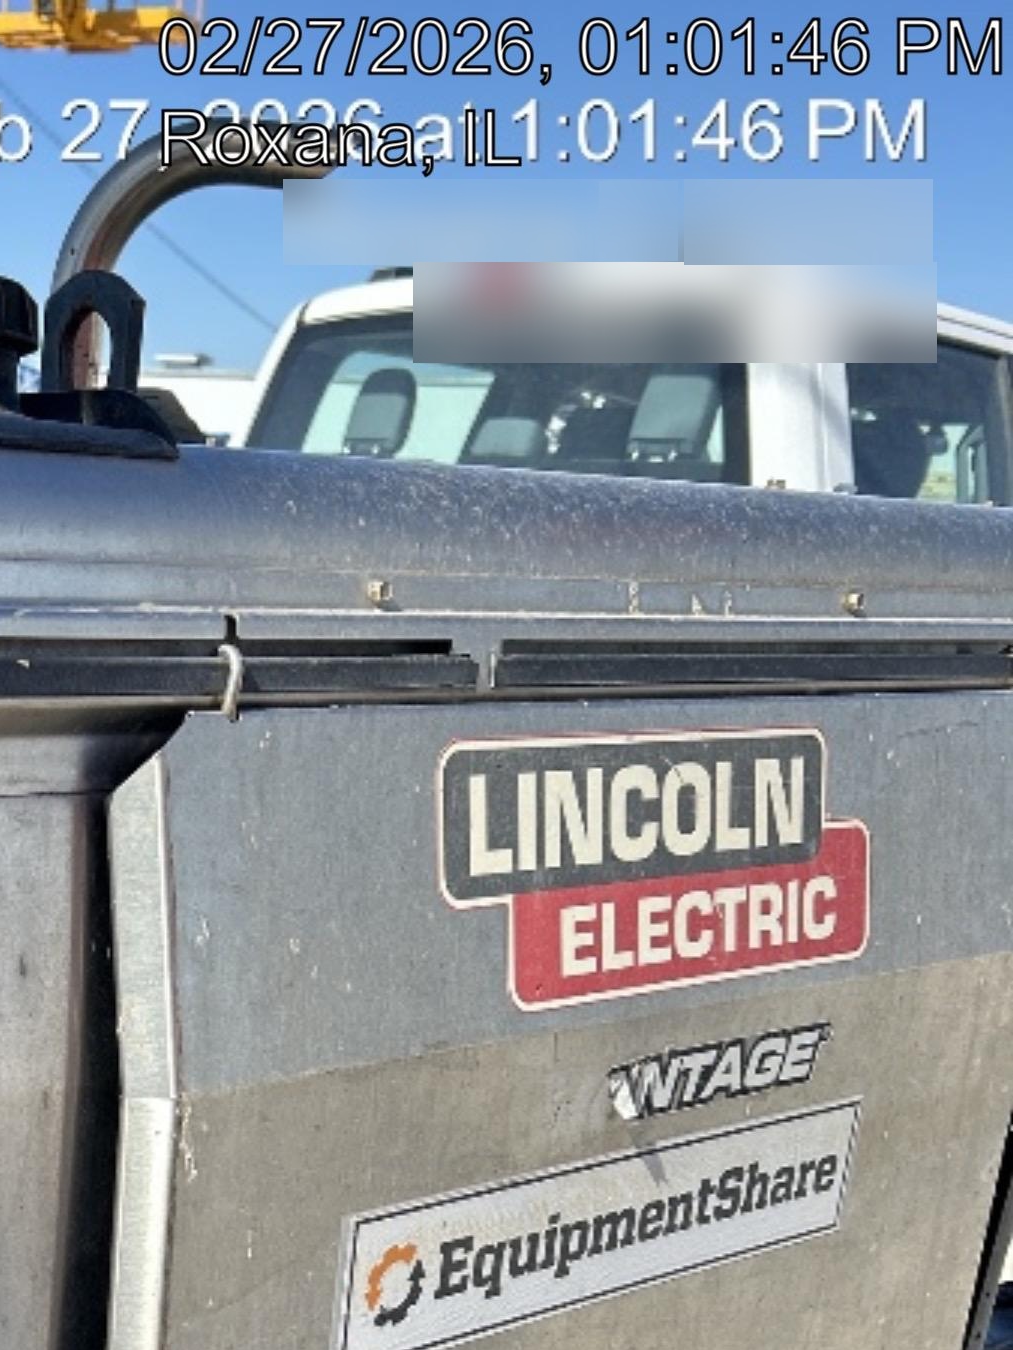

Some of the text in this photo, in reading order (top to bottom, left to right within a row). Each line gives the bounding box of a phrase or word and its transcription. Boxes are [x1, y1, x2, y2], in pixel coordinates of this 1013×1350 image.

[468, 756, 806, 878] LINCOLN
[559, 875, 838, 978] ELECTRIC
[433, 1153, 838, 1303] EquipmentShare
